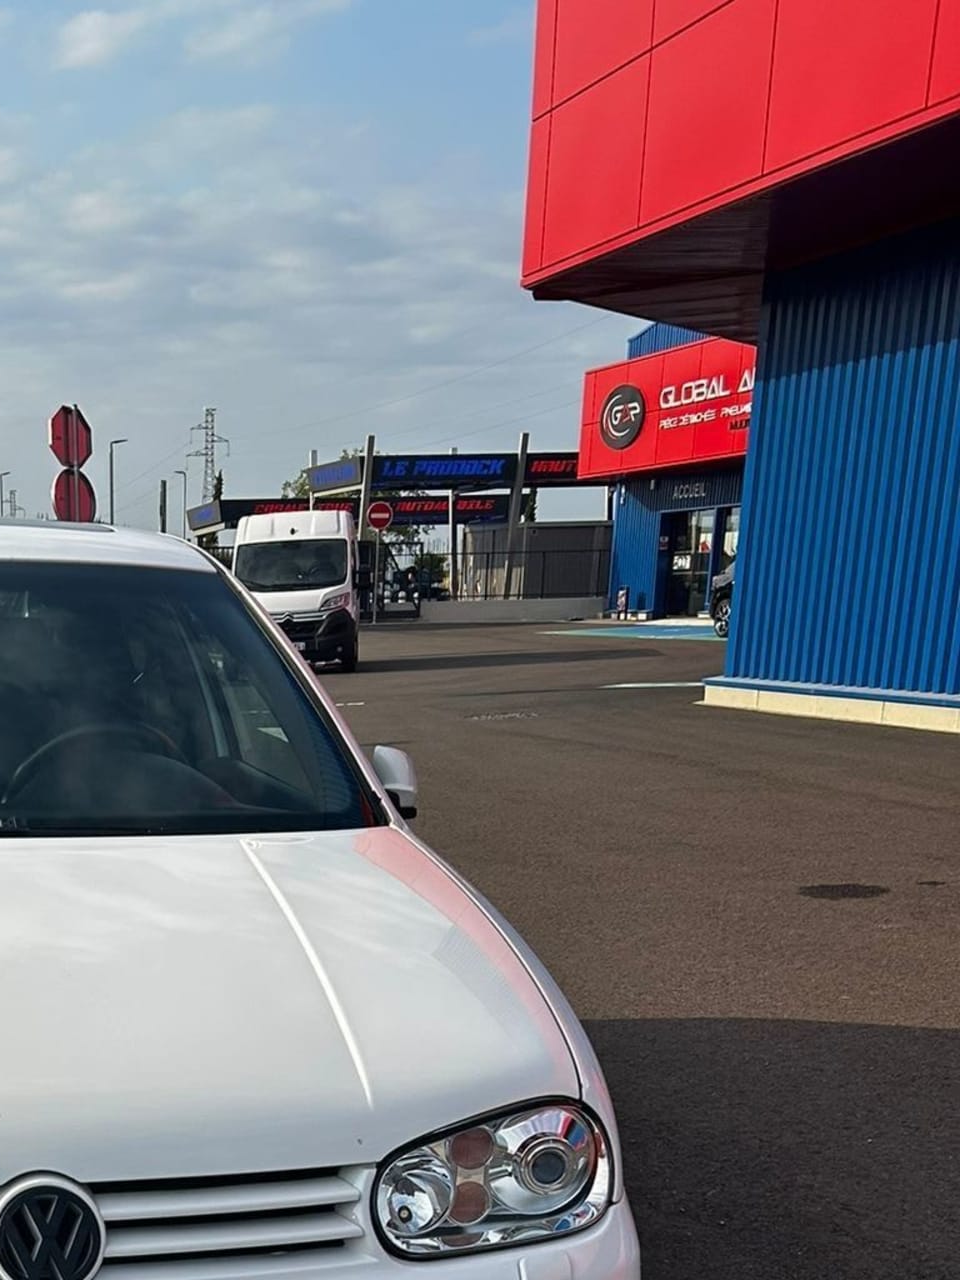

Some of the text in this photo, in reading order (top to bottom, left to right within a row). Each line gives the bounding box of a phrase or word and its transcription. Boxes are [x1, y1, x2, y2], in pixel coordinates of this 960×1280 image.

[659, 374, 732, 409] GLOBAL
[382, 460, 409, 476] LE
[672, 482, 706, 500] ACCUEIL
